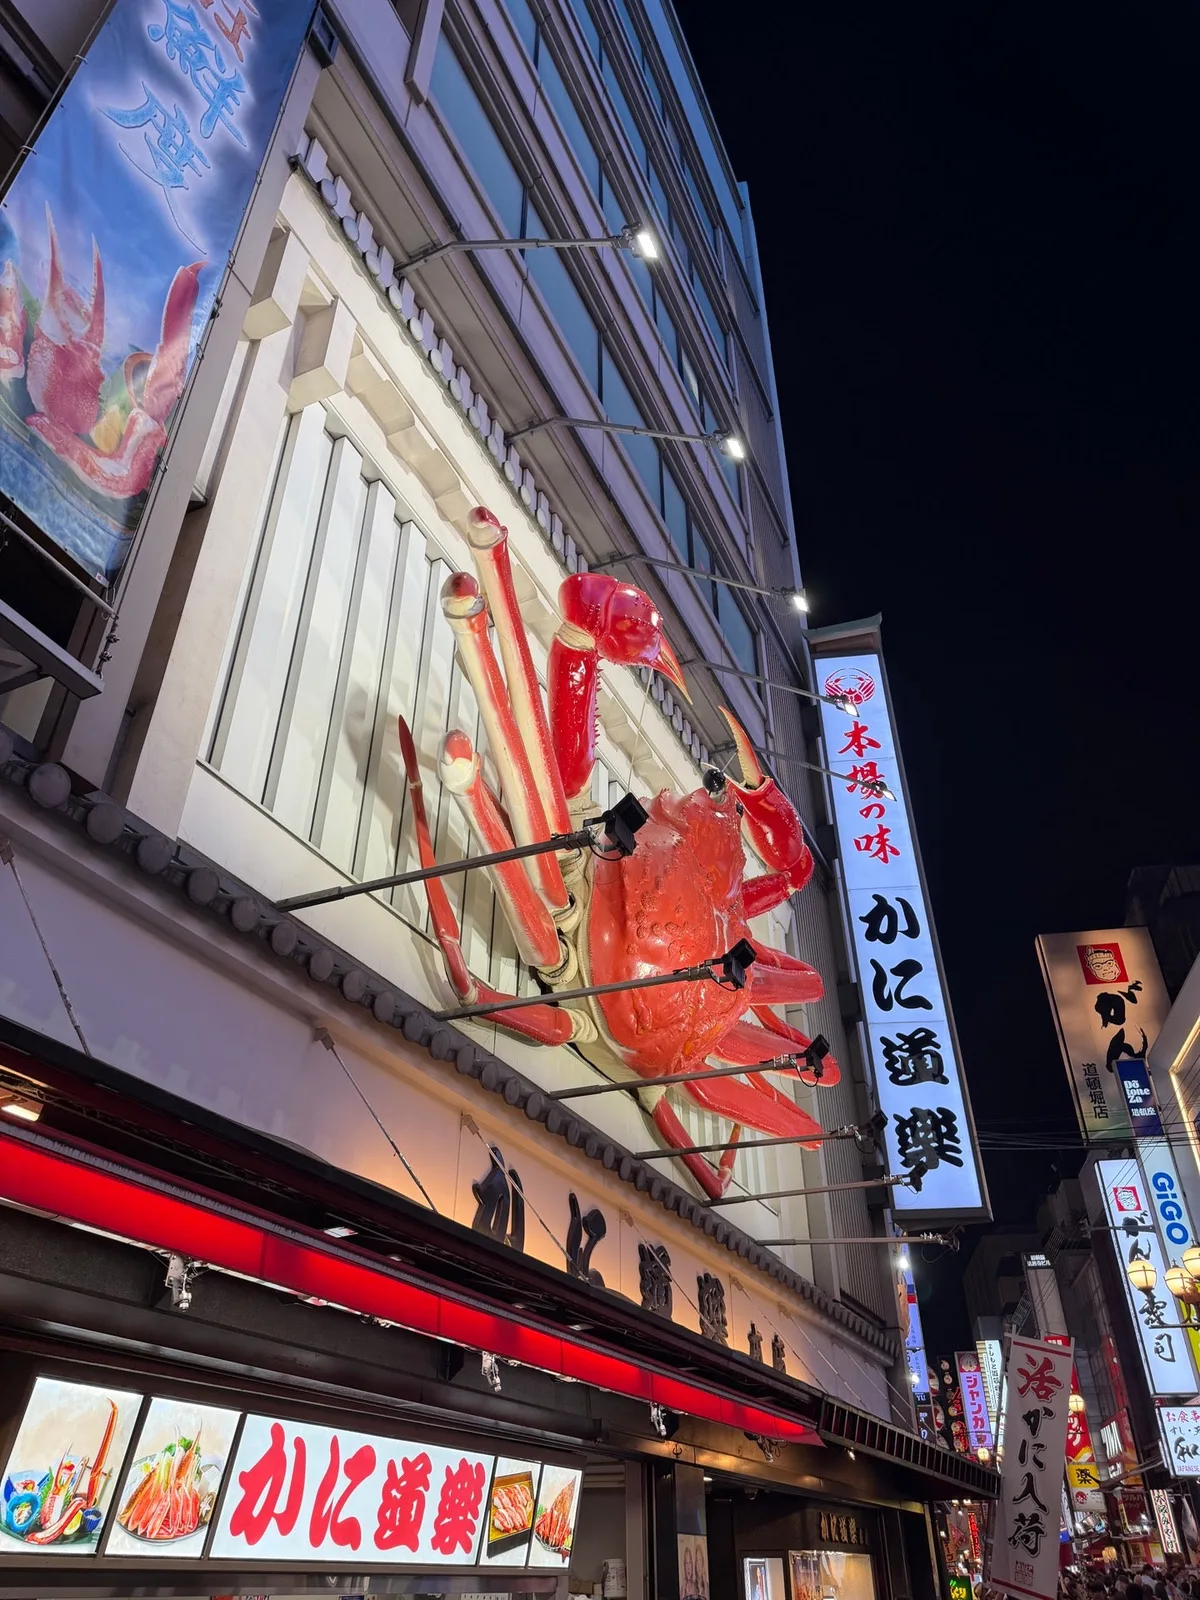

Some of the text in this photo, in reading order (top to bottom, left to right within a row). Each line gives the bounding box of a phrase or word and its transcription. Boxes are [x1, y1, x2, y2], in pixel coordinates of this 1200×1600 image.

[838, 720, 901, 865] 本場の味
[1095, 980, 1150, 1075] がん
[1082, 1063, 1109, 1119] 道頓堀店
[1152, 1172, 1189, 1245] GiGO
[1008, 1353, 1063, 1558] 活かに入荷
